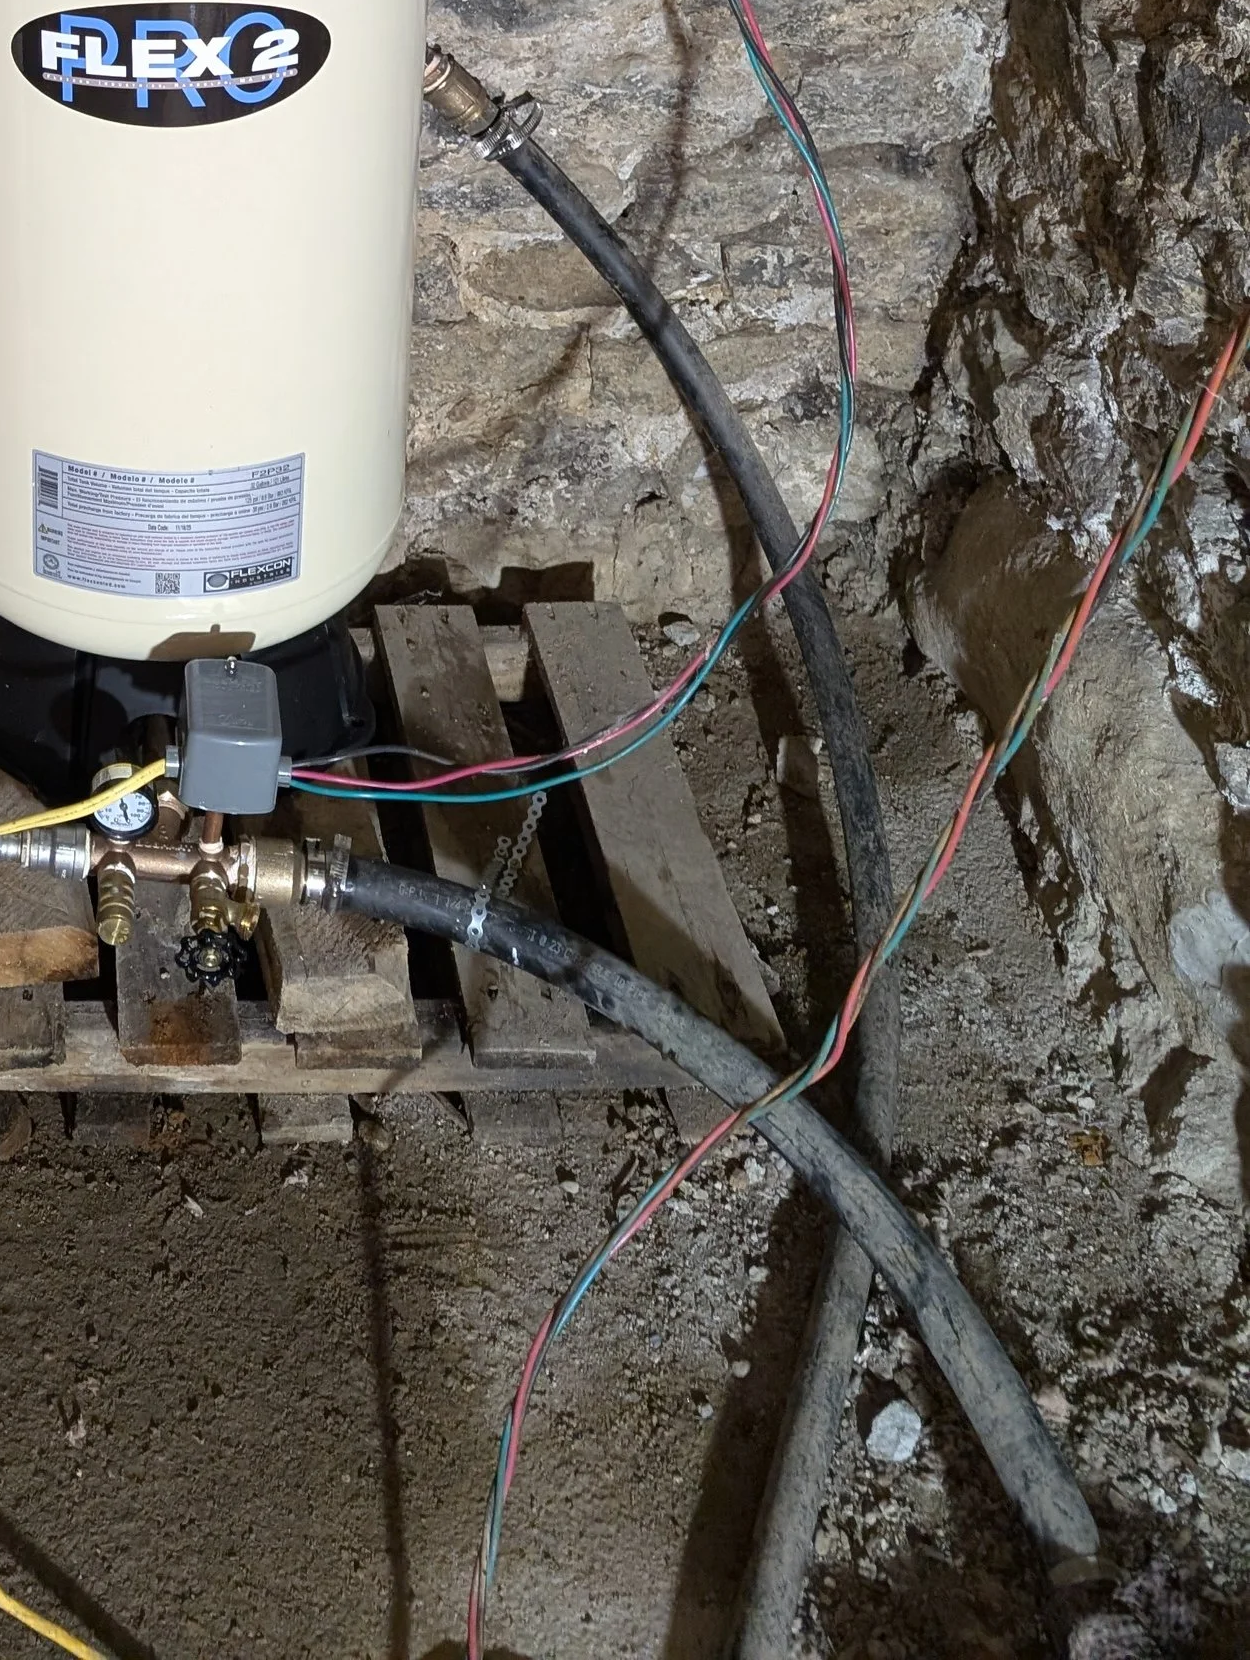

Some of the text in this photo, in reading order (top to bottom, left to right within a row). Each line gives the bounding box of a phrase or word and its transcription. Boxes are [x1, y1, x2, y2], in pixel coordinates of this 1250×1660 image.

[41, 28, 300, 78] FLEX 2
[60, 12, 291, 108] PRO
[68, 465, 91, 476] Model
[231, 558, 291, 578] FLEXCON
